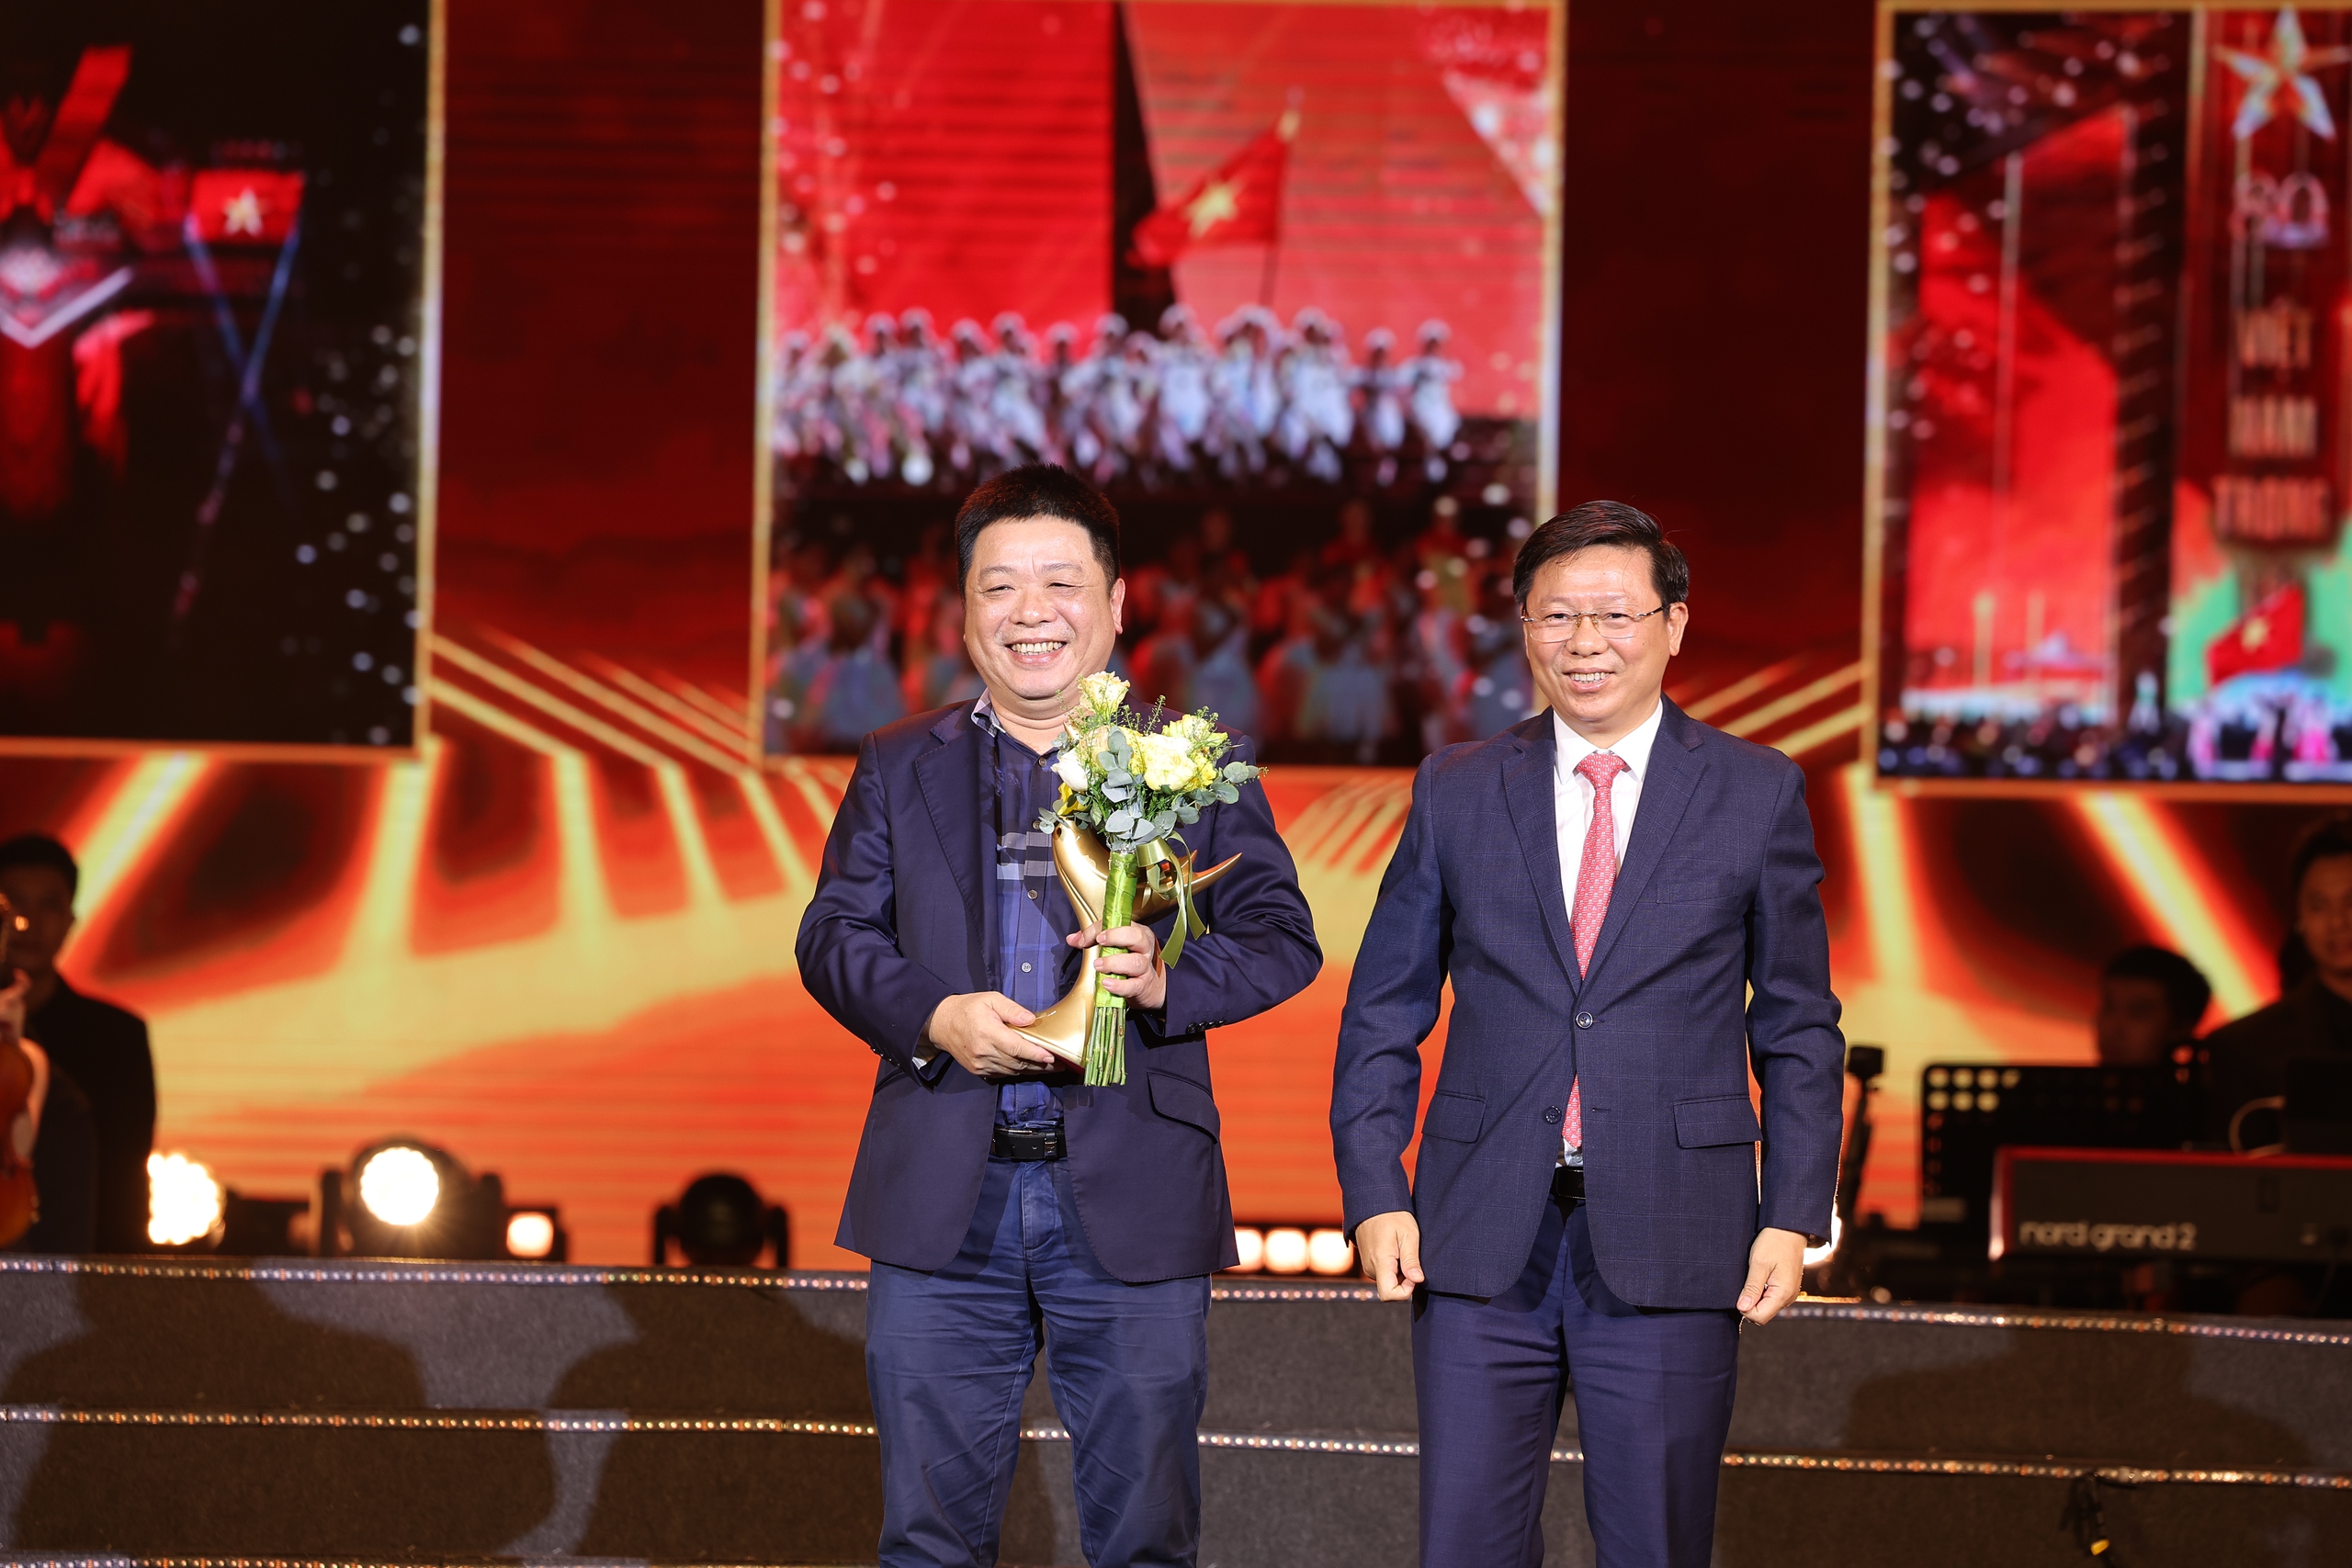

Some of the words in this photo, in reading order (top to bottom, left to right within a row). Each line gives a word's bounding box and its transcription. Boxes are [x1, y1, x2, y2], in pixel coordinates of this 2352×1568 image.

[2019, 1220, 2088, 1247] nord
[2089, 1222, 2177, 1252] grand
[2177, 1222, 2198, 1251] 2
